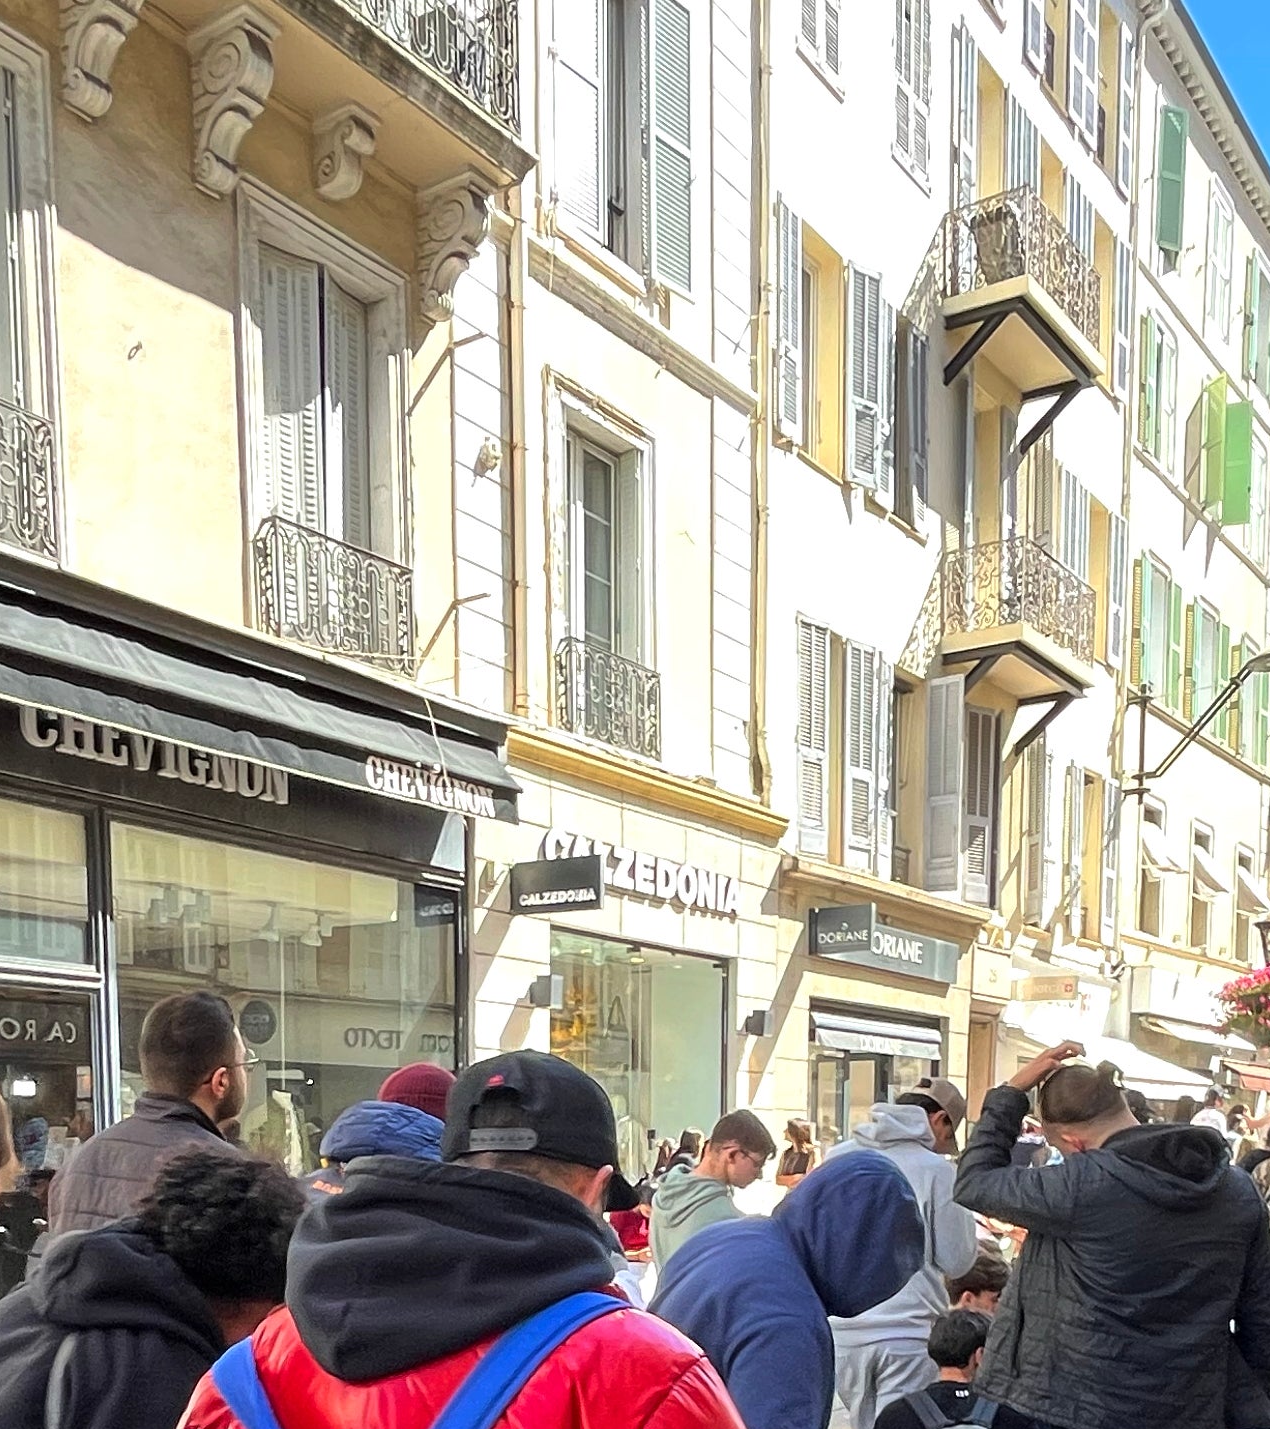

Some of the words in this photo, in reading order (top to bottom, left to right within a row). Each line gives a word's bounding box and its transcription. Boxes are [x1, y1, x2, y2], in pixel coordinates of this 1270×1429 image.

[18, 703, 289, 804] CHEVIGNON
[365, 755, 496, 818] CHEVIGNON
[518, 887, 597, 907] CALZEDONIA
[818, 929, 869, 944] DORIANE
[872, 931, 924, 964] ORIANE
